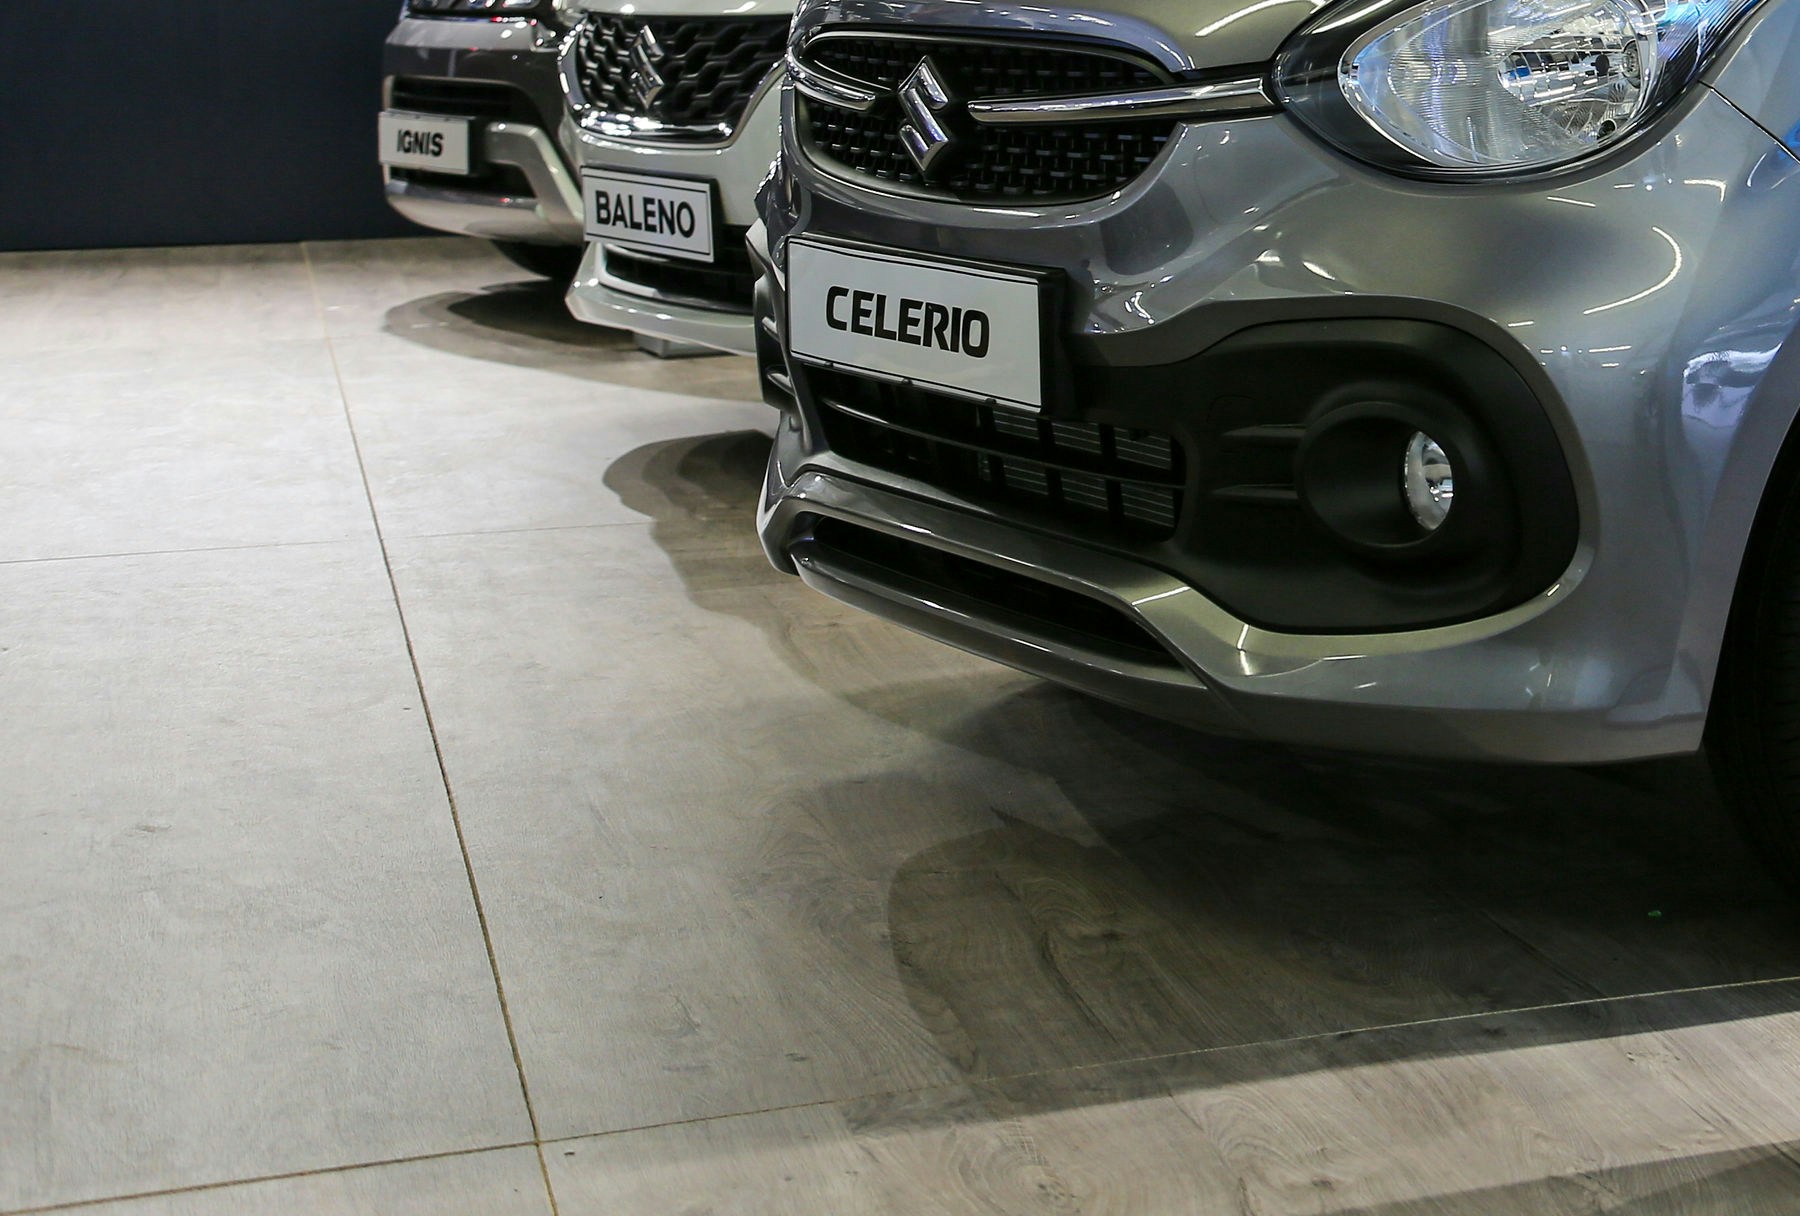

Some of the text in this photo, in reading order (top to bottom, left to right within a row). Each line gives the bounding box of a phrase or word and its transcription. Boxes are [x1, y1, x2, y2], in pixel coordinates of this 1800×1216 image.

[396, 129, 445, 158] IGNIS
[595, 190, 696, 239] BALENO
[825, 285, 990, 359] CELERIO
